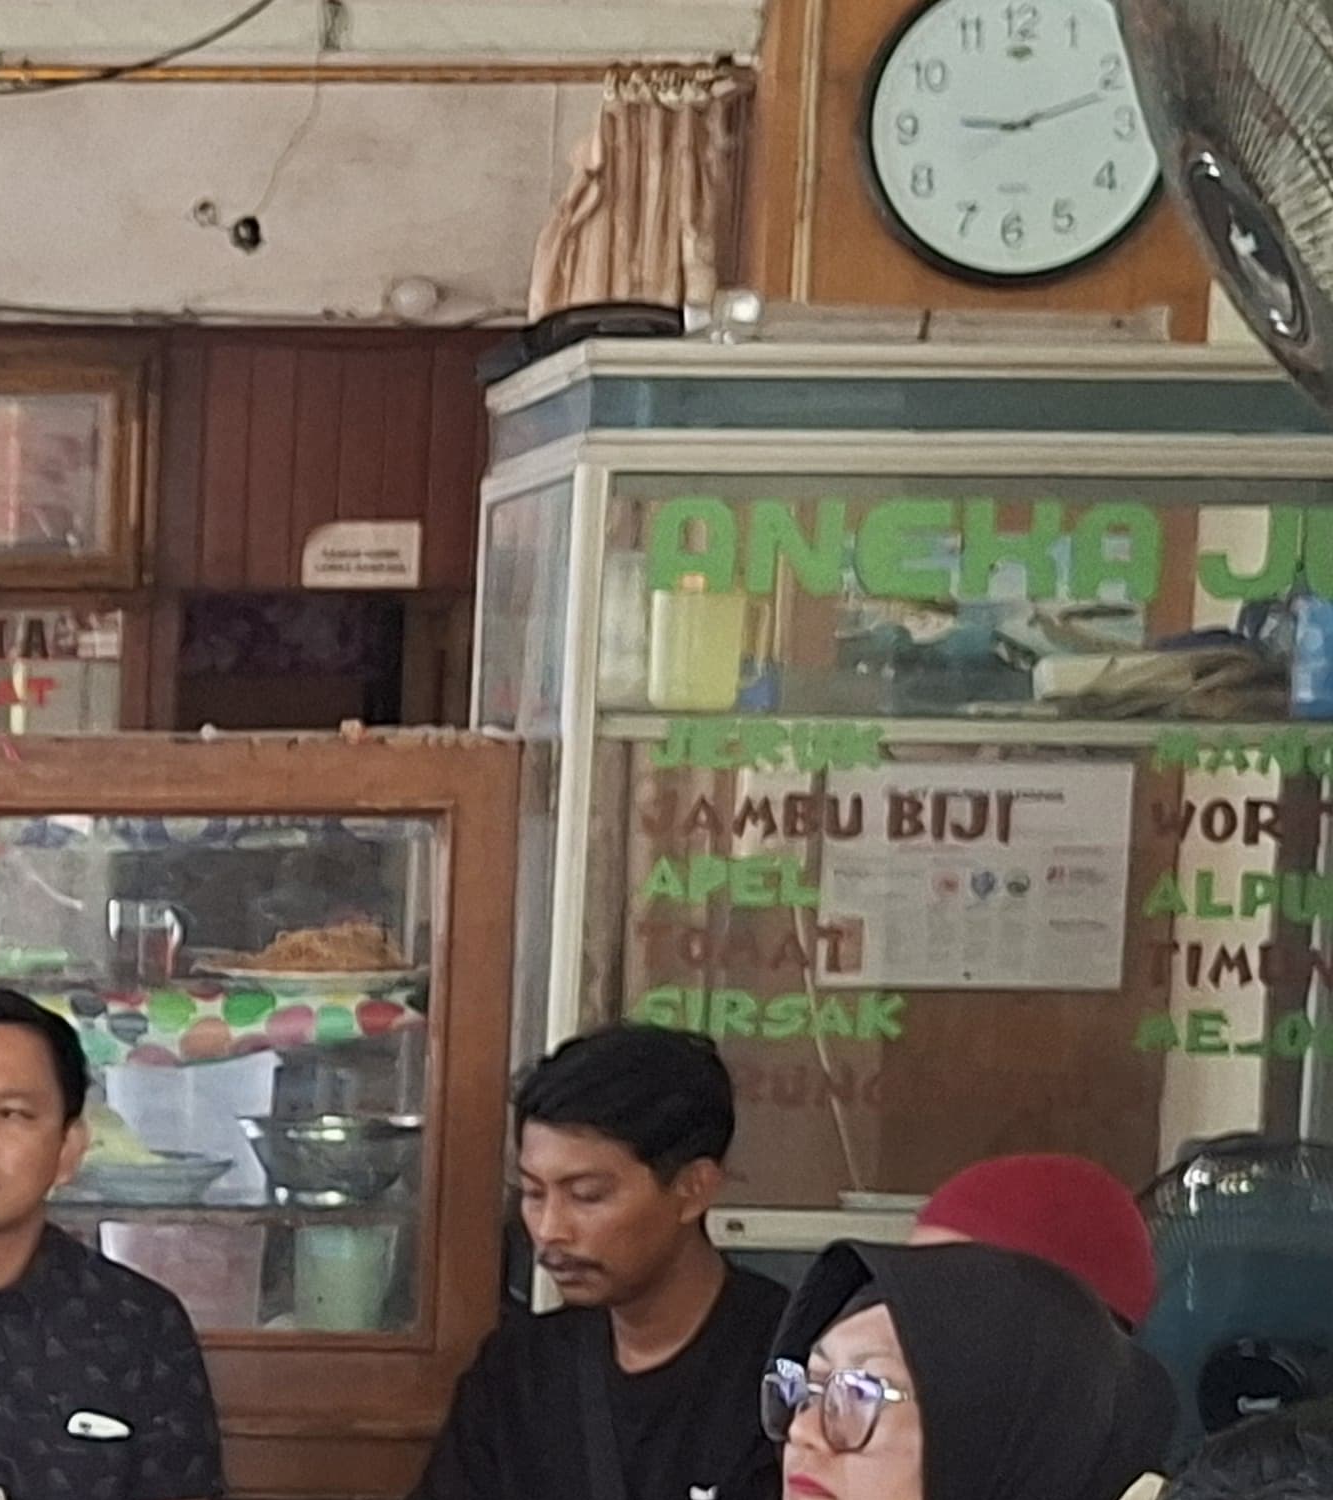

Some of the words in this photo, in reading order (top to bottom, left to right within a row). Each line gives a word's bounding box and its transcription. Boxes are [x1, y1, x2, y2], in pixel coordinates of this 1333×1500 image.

[959, 15, 985, 52] 11
[1004, 2, 1038, 40] 12
[1065, 15, 1079, 49] 1
[912, 58, 950, 93] 10
[1098, 51, 1125, 91] 2
[896, 109, 920, 146] 9
[909, 161, 936, 199] 8
[1091, 159, 1118, 193] 4
[955, 199, 981, 238] 7
[999, 209, 1024, 249] 6
[1051, 196, 1076, 234] 5
[648, 496, 1161, 602] ANEKA
[641, 790, 864, 842] JAMBU
[886, 787, 1015, 844] BIJI
[641, 855, 820, 907] APEL
[628, 985, 906, 1041] SIRSAK
